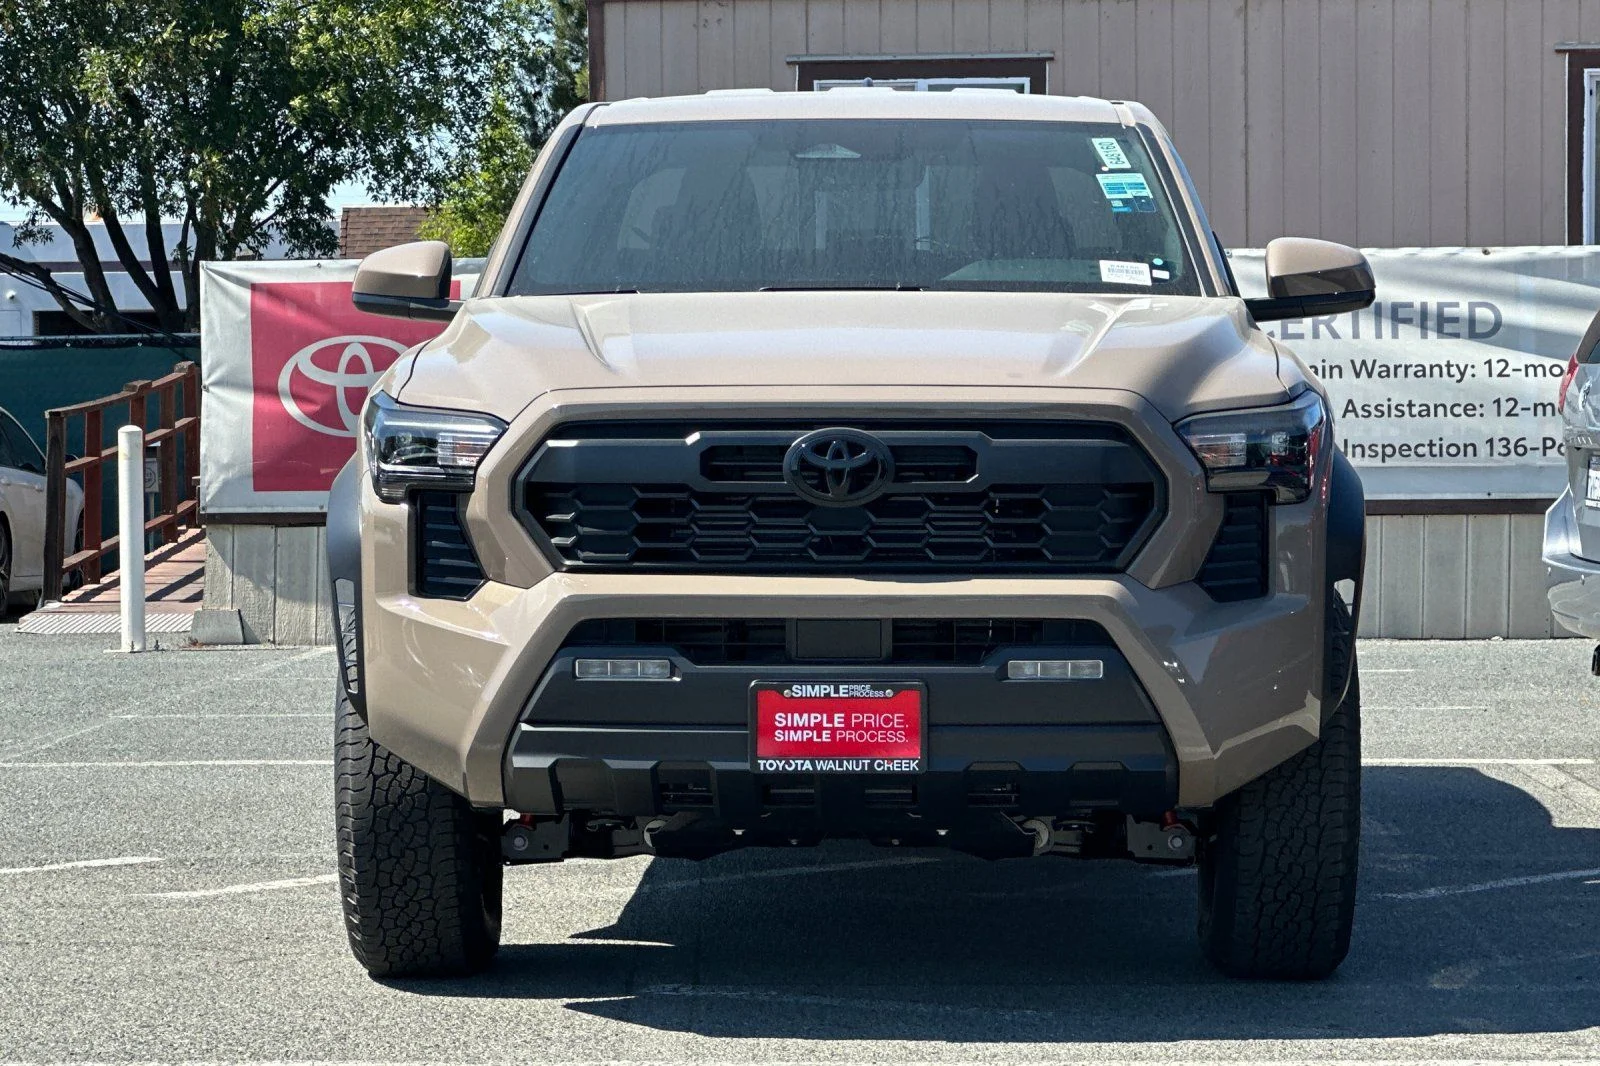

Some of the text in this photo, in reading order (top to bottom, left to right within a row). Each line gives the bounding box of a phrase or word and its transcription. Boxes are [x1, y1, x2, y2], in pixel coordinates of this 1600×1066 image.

[1267, 302, 1502, 340] ERTIFIED
[1350, 359, 1476, 383] Warranty:
[1341, 397, 1562, 418] Assistance: 12-m
[1343, 437, 1478, 463] Inspection
[791, 684, 849, 698] SIMPLE
[774, 713, 909, 728] SIMPLE PRICE.
[774, 730, 909, 743] SIMPLE PROCESS.
[757, 759, 919, 772] TOYOTA WALNUT CREEK
